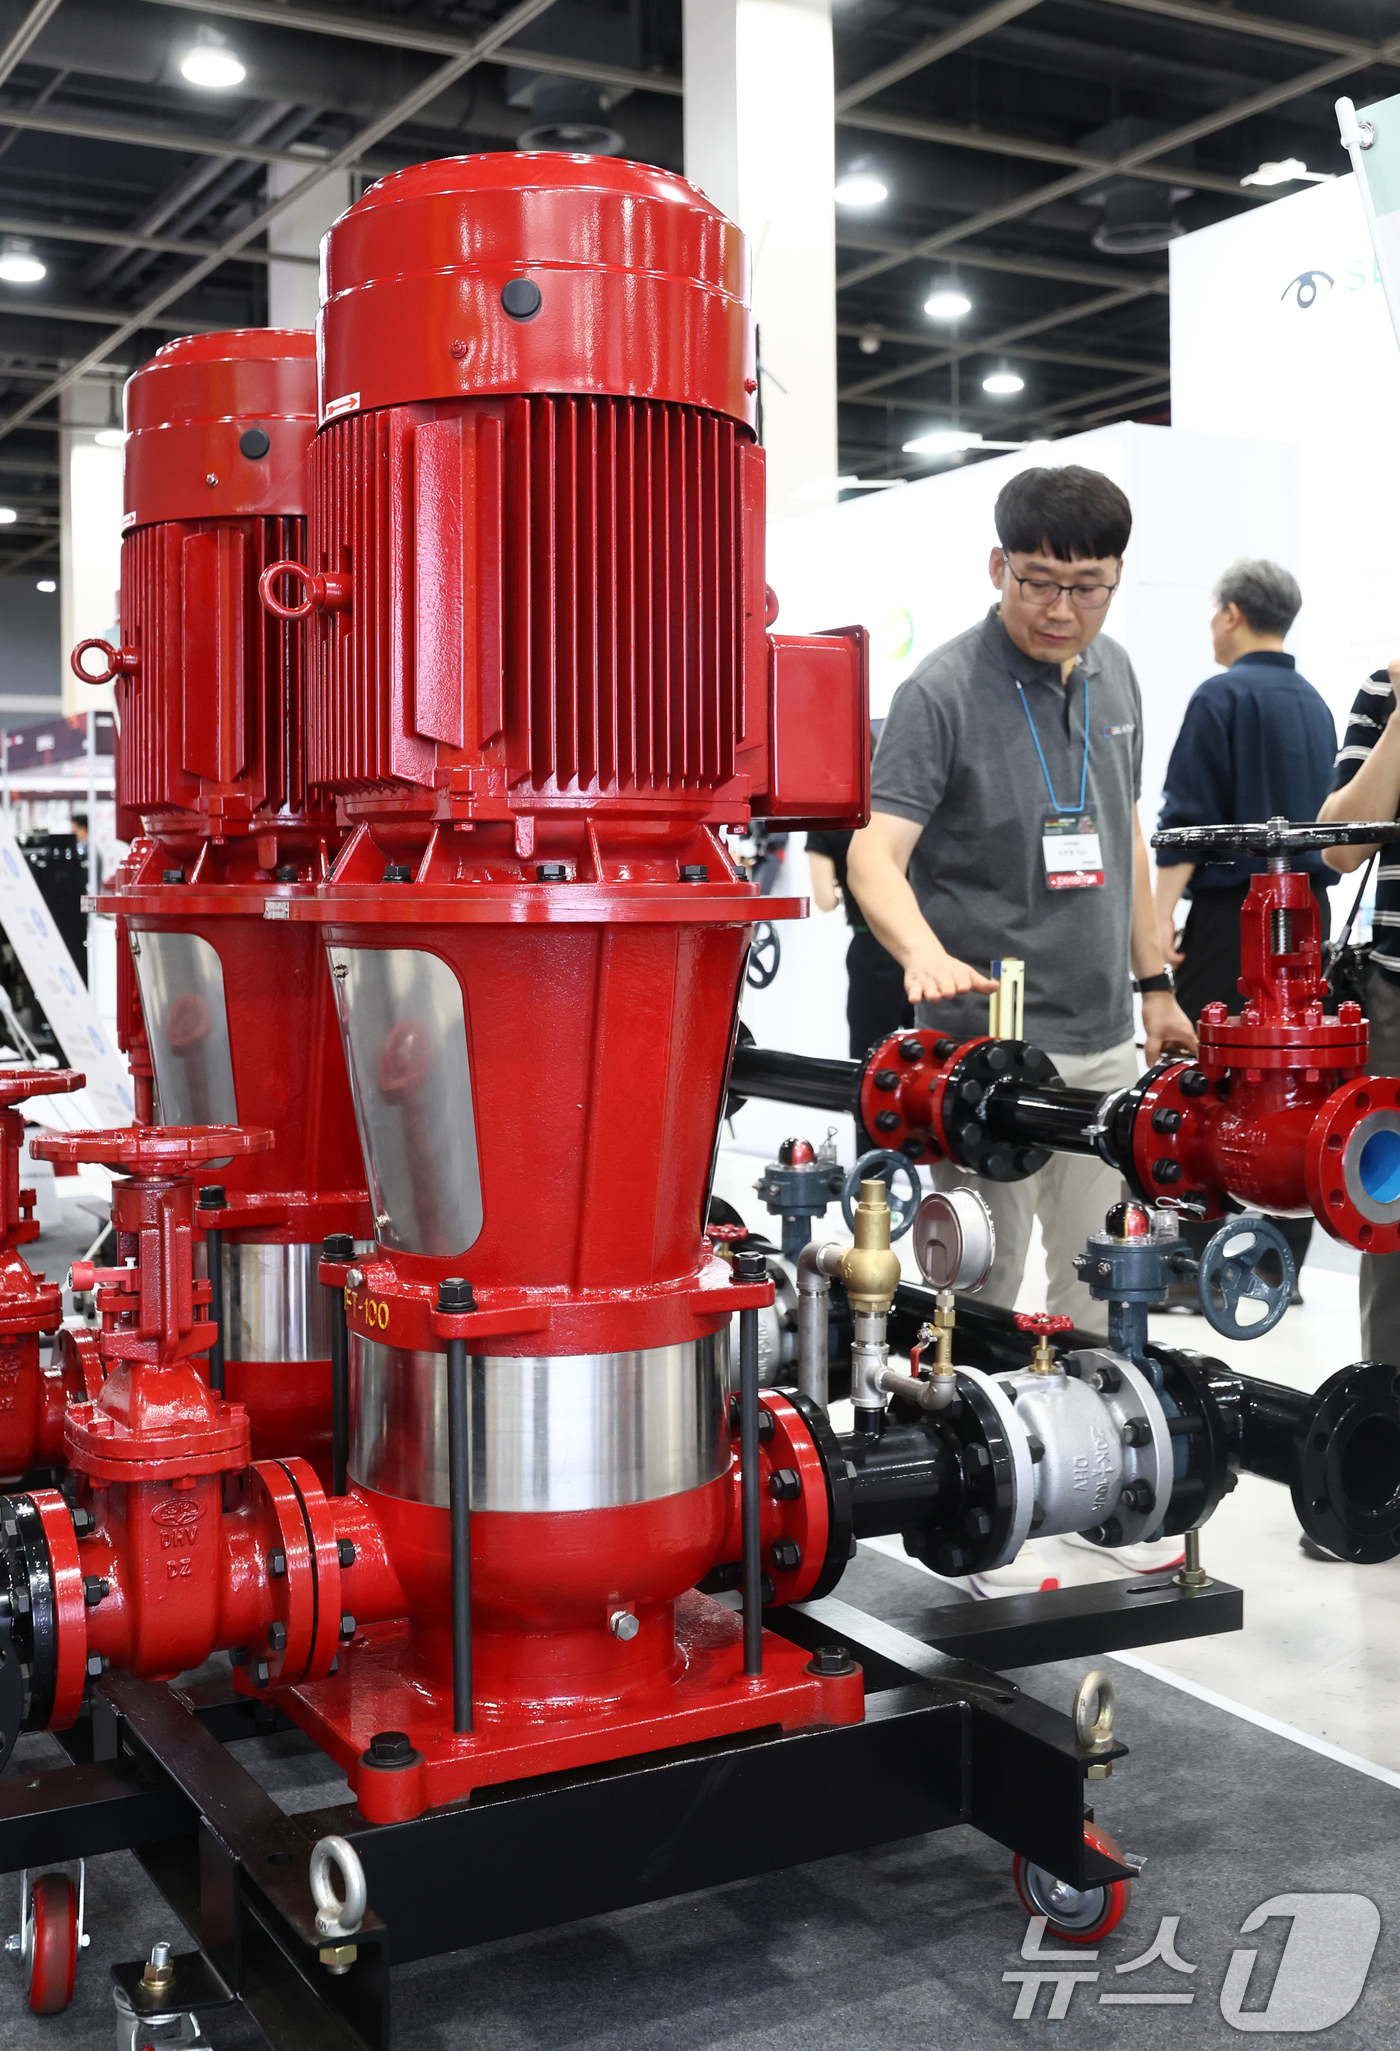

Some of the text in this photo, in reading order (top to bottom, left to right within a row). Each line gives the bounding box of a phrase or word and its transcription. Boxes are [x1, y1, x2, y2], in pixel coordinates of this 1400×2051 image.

[1072, 1455, 1090, 1492] DHV
[160, 1526, 198, 1549] DHV
[166, 1557, 192, 1579] DZ
